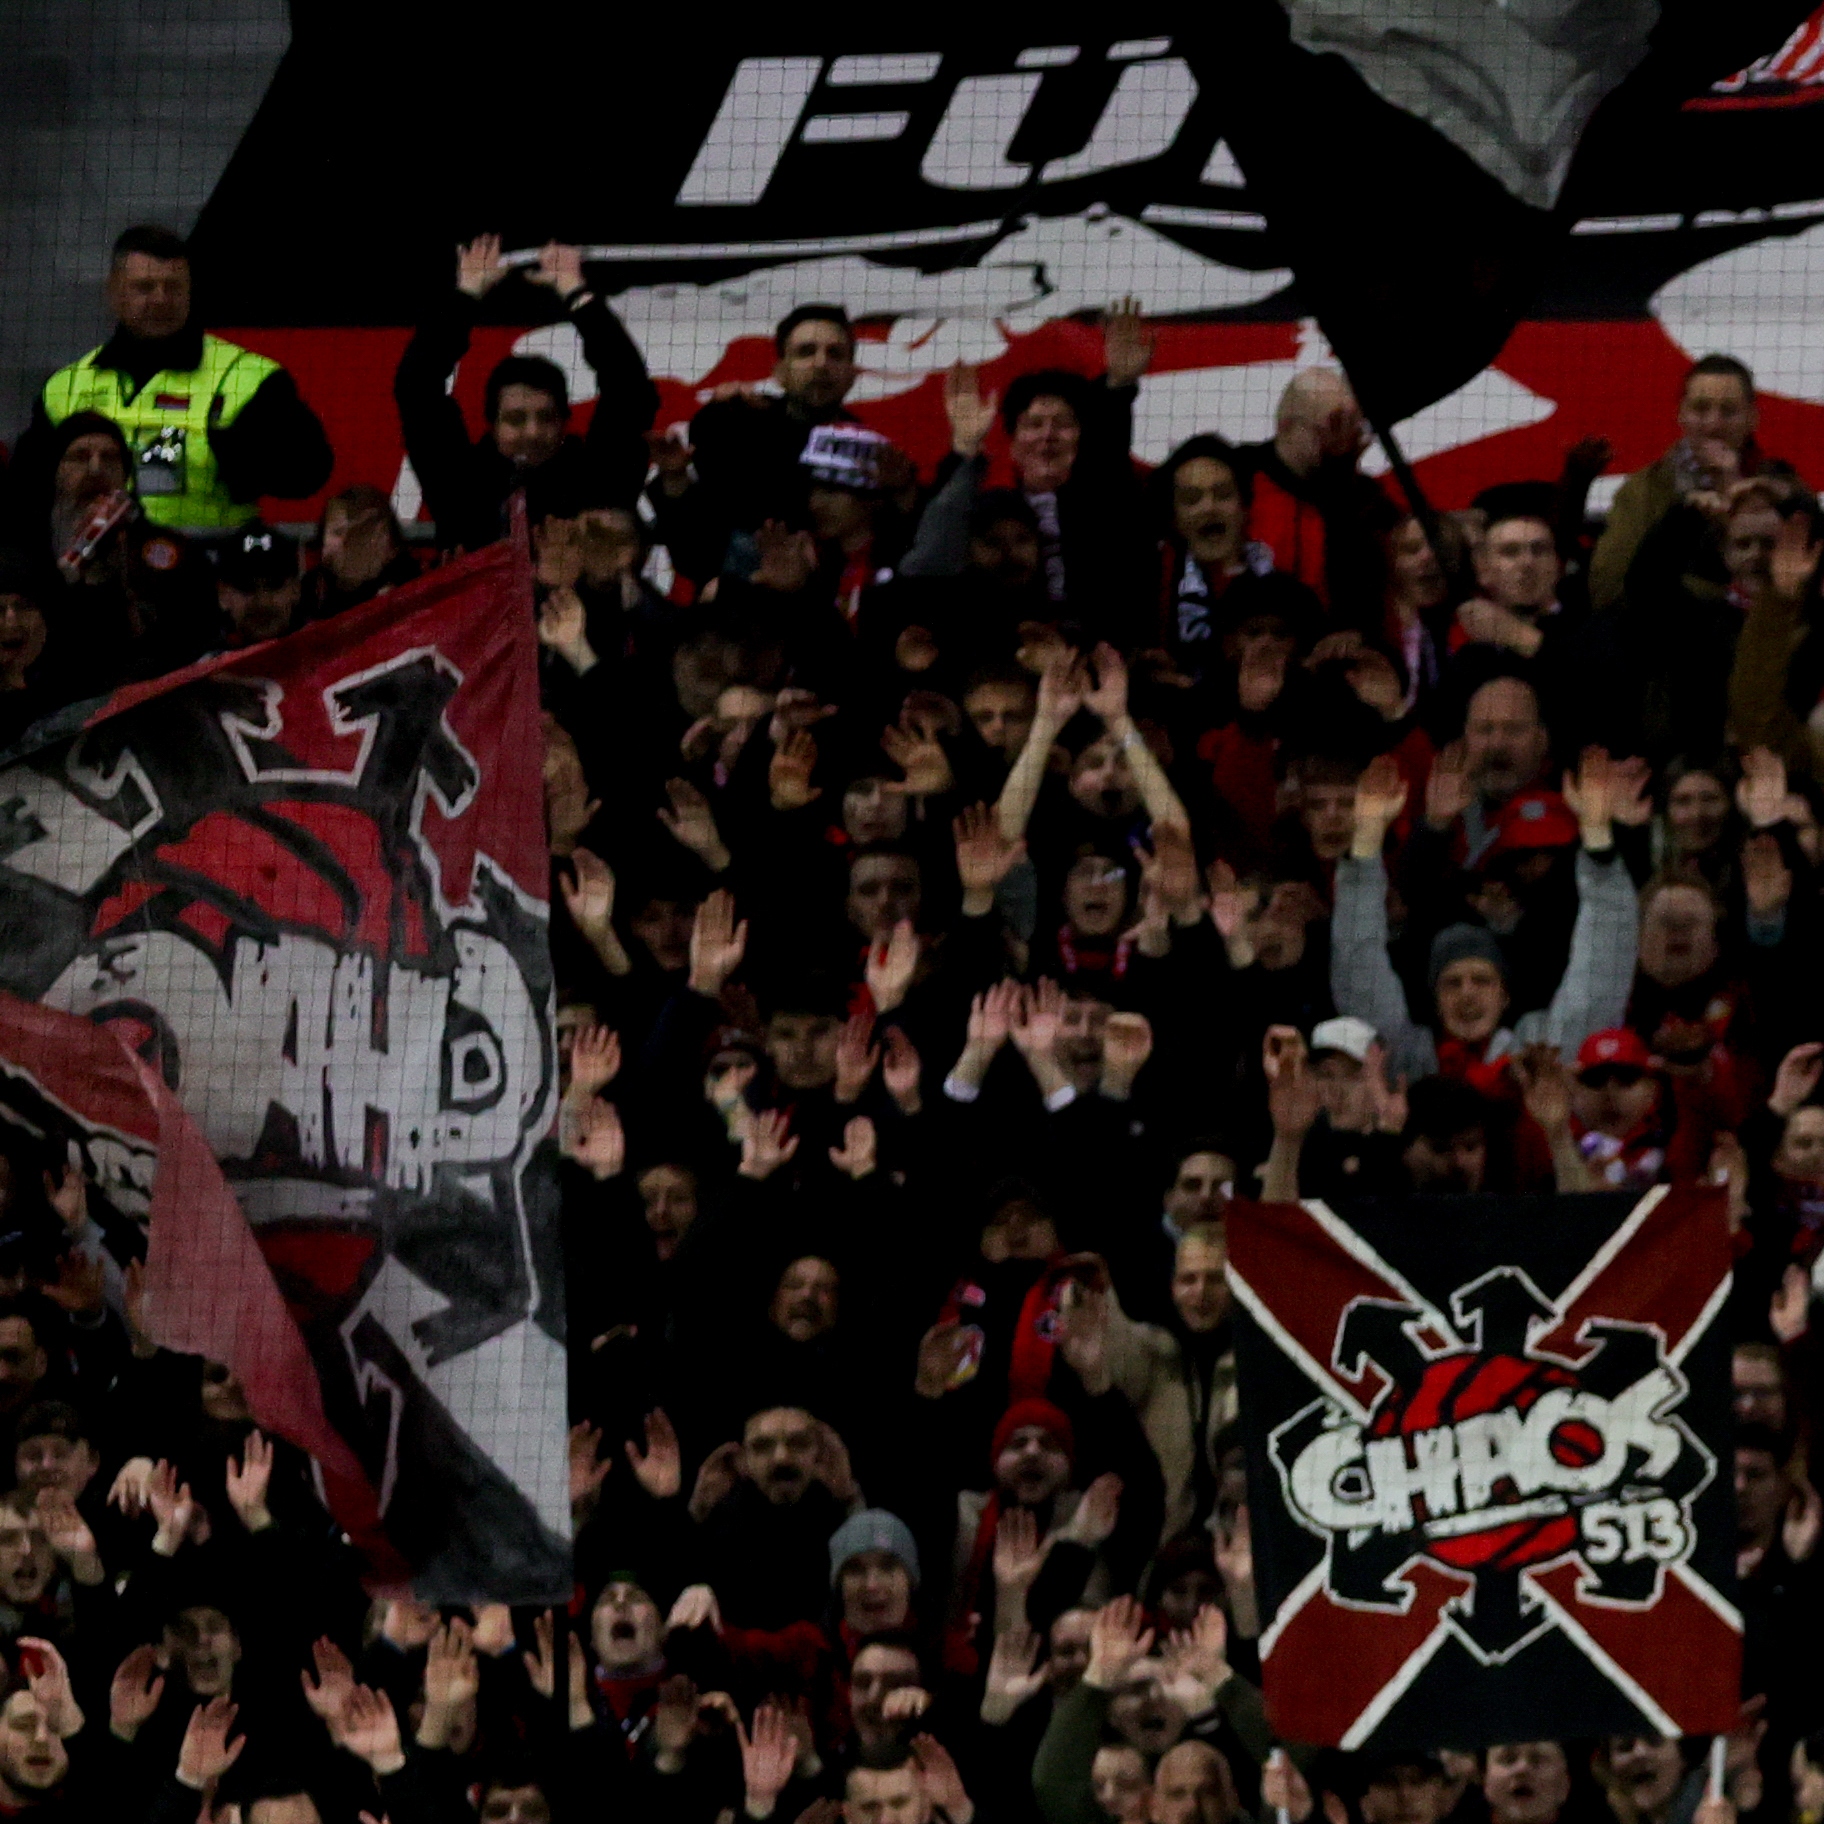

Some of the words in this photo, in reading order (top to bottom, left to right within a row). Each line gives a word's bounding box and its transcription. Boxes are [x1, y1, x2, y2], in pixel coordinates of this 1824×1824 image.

[675, 38, 1250, 206] FÜ
[1291, 1369, 1682, 1545] CHAOS
[1581, 1499, 1686, 1563] 513
